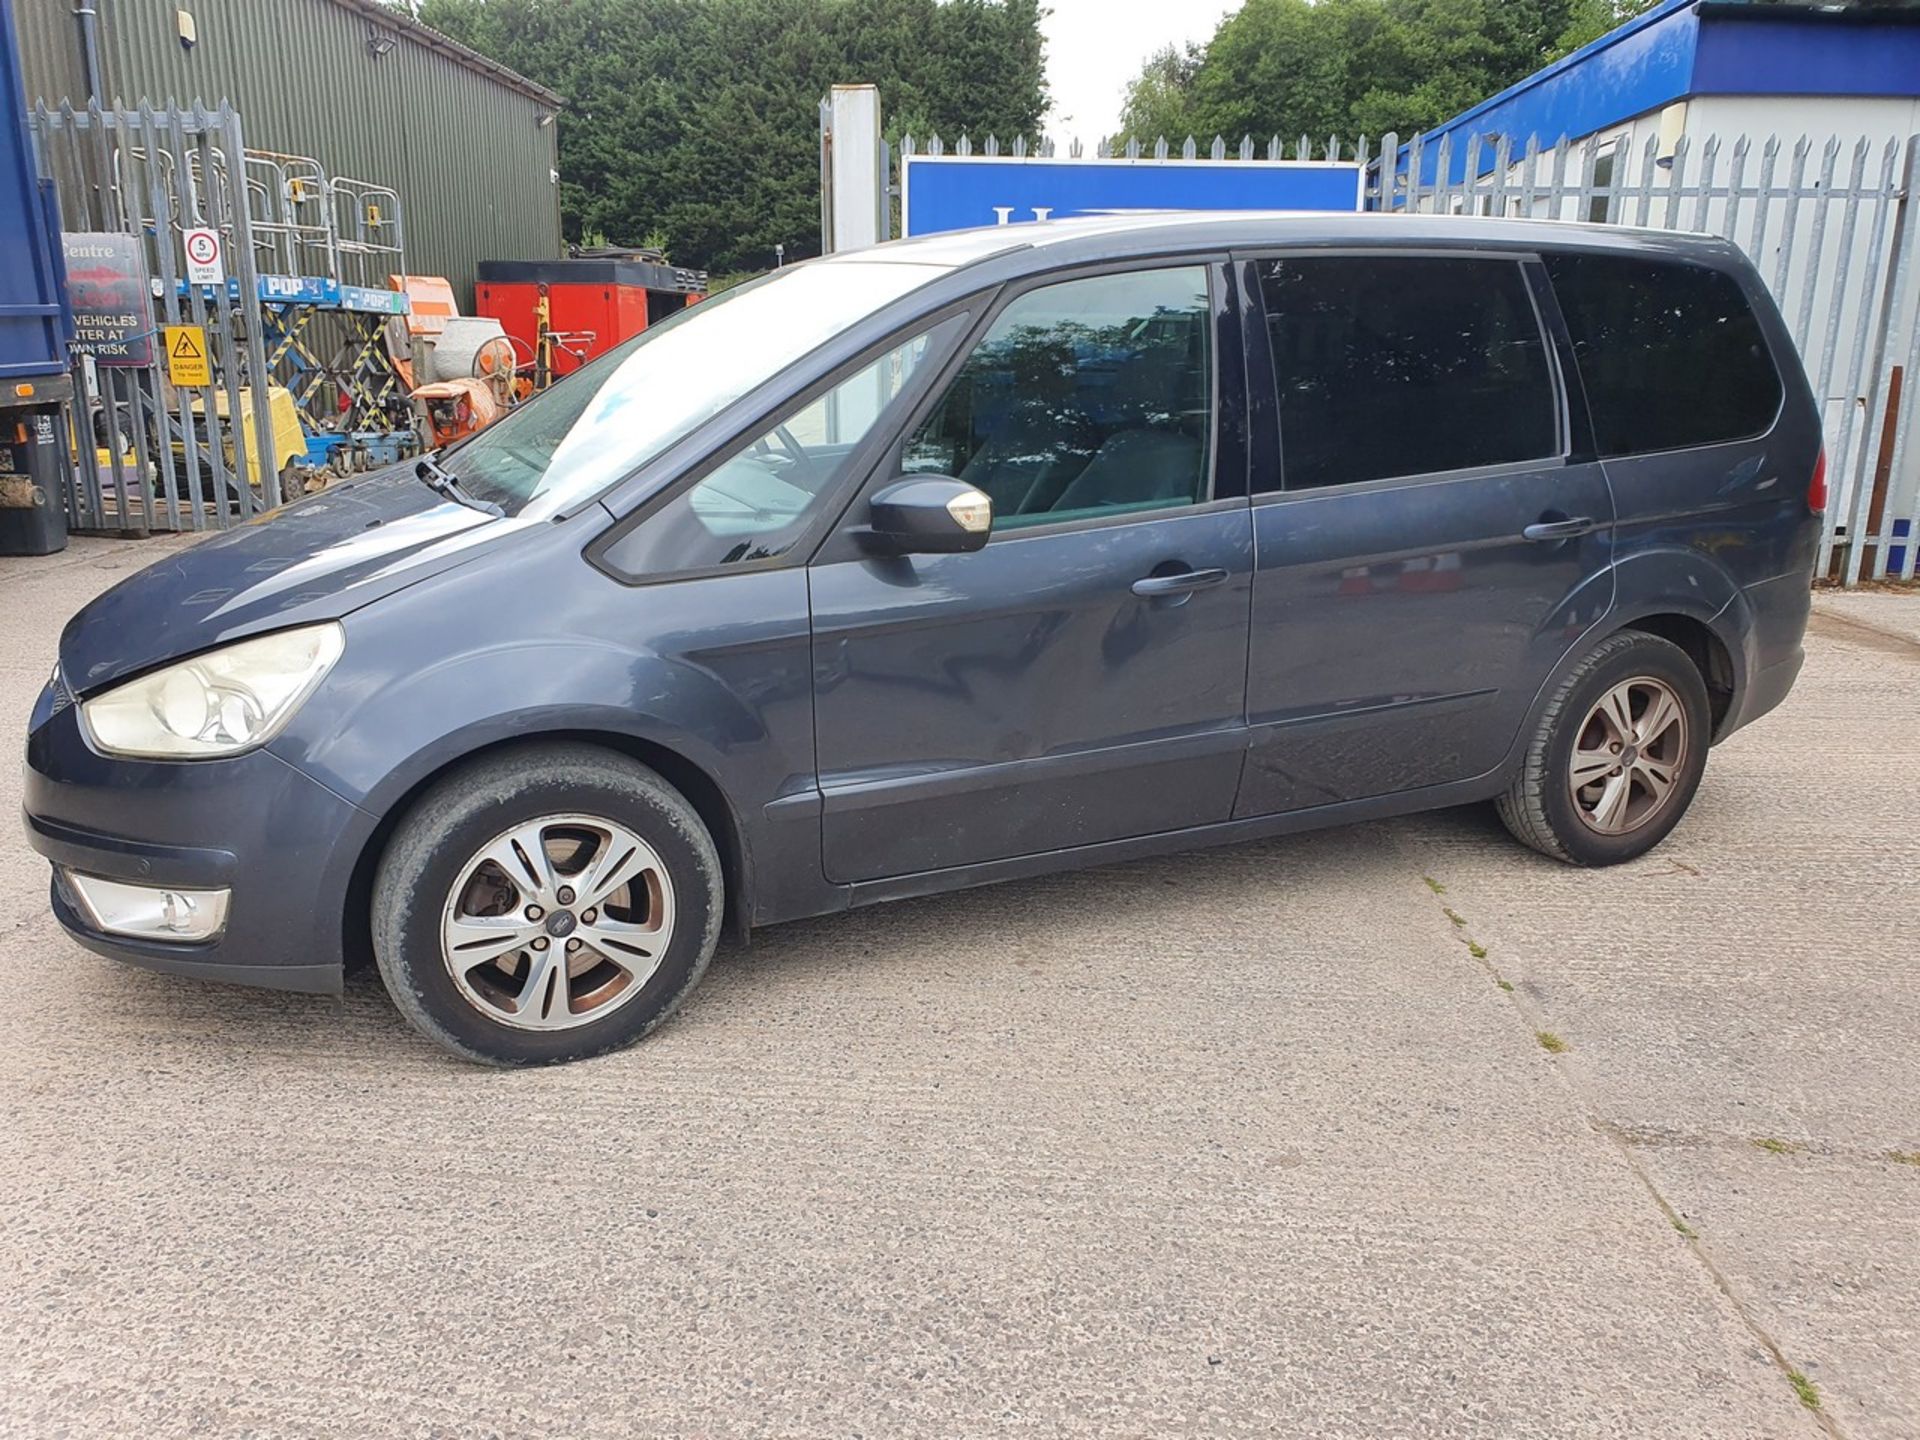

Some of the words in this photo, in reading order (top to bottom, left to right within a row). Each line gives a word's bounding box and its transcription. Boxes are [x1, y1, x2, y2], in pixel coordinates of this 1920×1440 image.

[198, 239, 206, 251] 5
[267, 277, 304, 296] POP
[73, 314, 138, 327] VEHICLES
[108, 329, 125, 341] AT
[98, 343, 129, 355] RISK
[173, 363, 204, 371] DANGER
